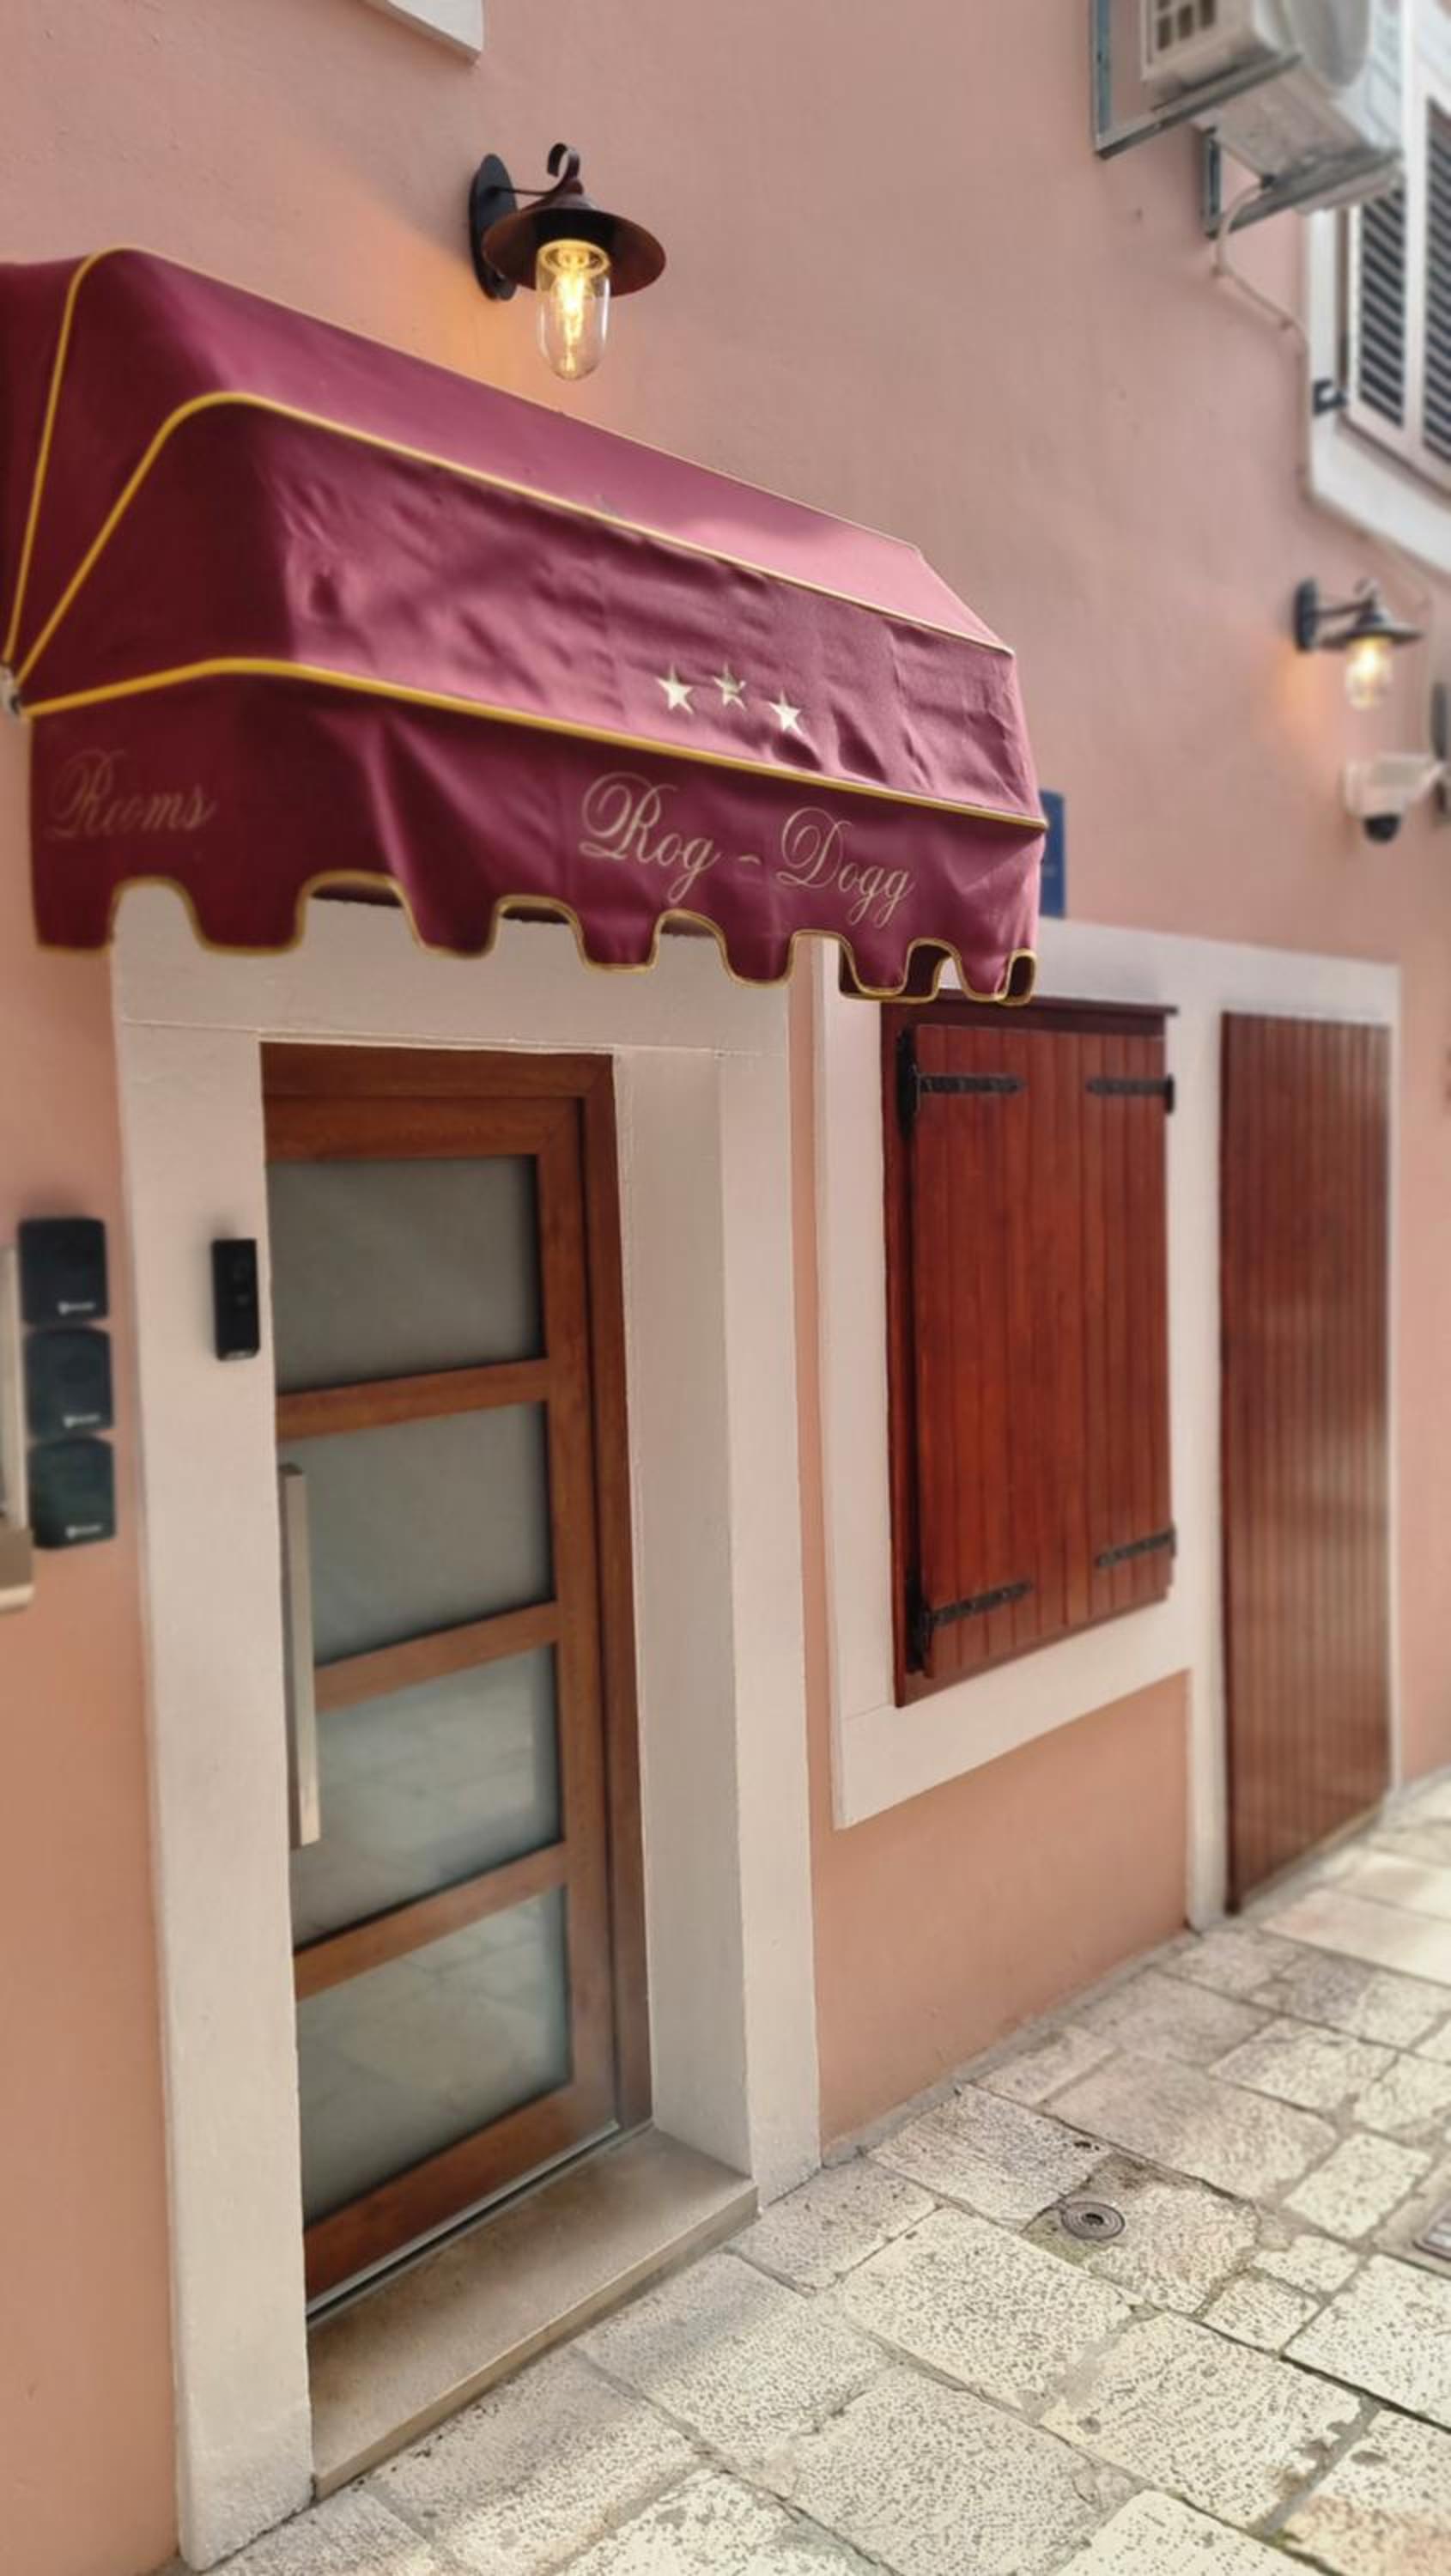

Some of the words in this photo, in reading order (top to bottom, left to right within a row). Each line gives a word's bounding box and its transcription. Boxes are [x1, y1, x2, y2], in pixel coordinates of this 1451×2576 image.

[48, 747, 216, 838] Rooms
[580, 772, 721, 903] Rog
[776, 806, 915, 928] Dogg
